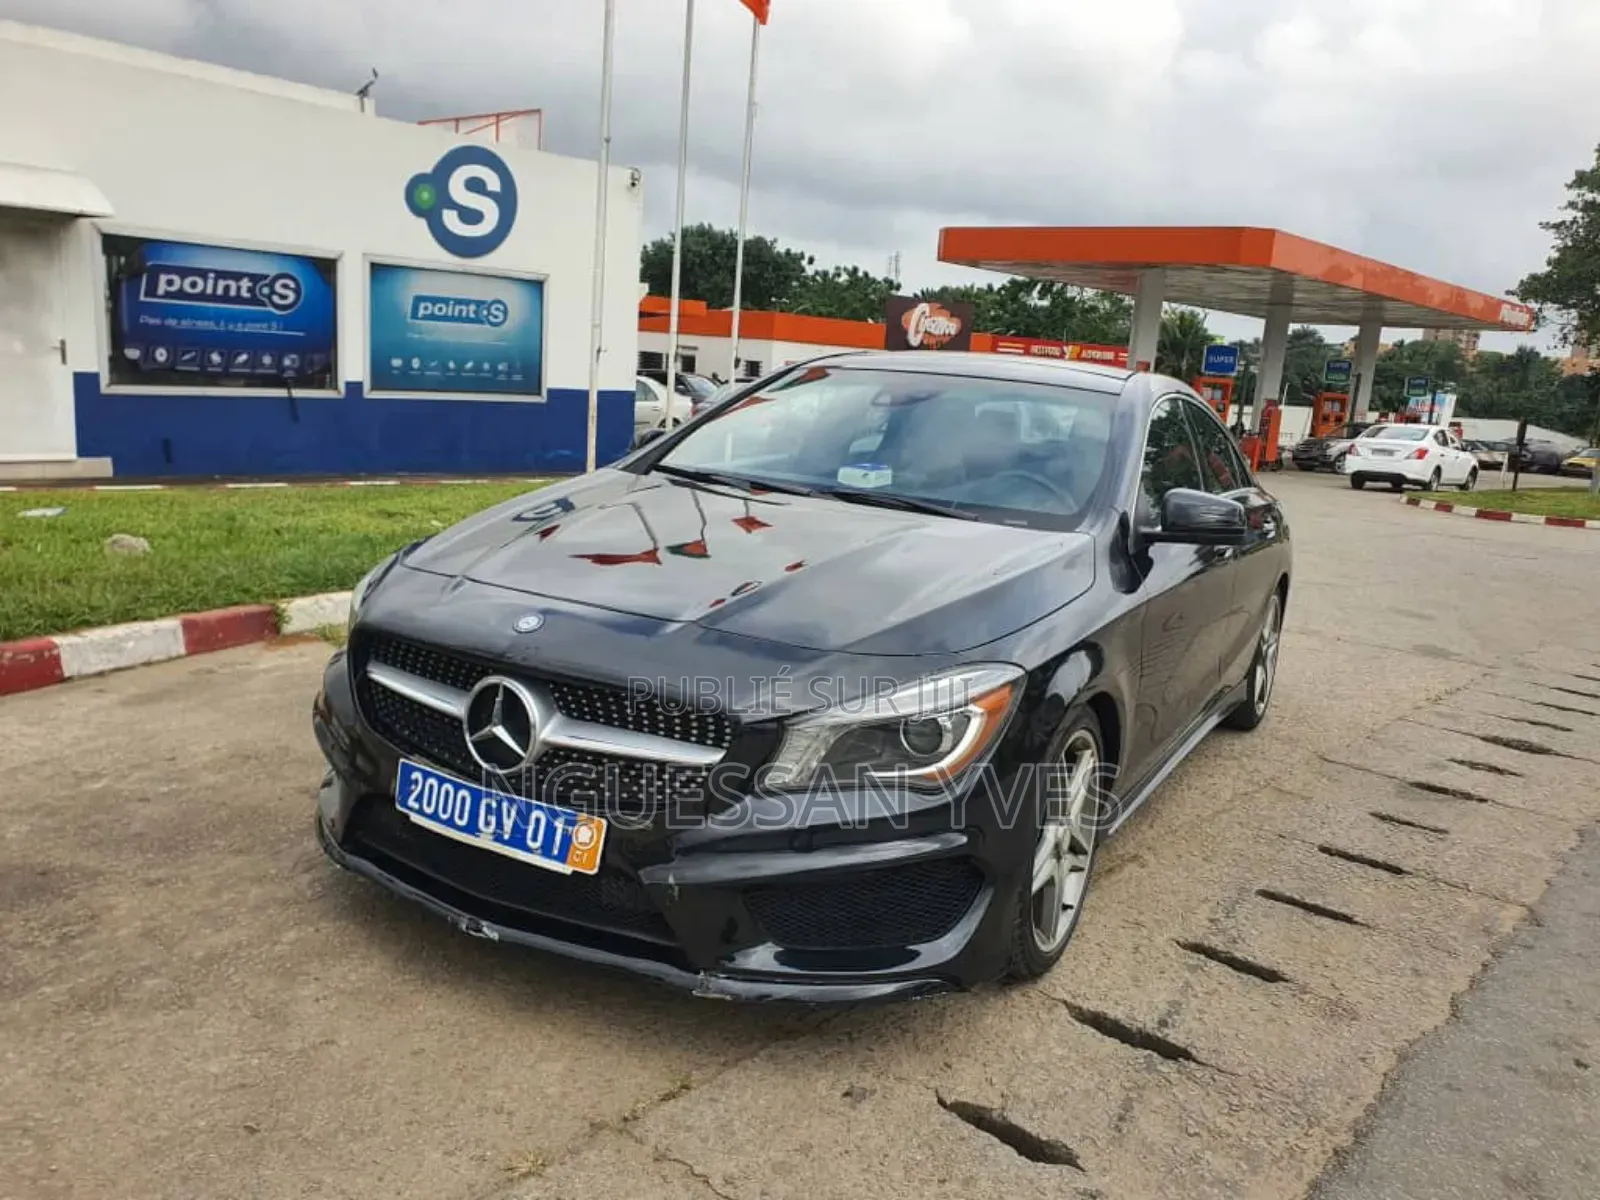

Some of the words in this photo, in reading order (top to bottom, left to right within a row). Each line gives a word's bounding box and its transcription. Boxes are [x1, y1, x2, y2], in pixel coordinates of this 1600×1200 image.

[442, 164, 501, 237] S
[156, 272, 253, 298] point
[271, 278, 297, 305] S
[418, 300, 476, 318] point
[488, 303, 505, 323] S
[1208, 355, 1234, 364] SUPER
[407, 771, 471, 827] 2000
[478, 797, 518, 841] GV
